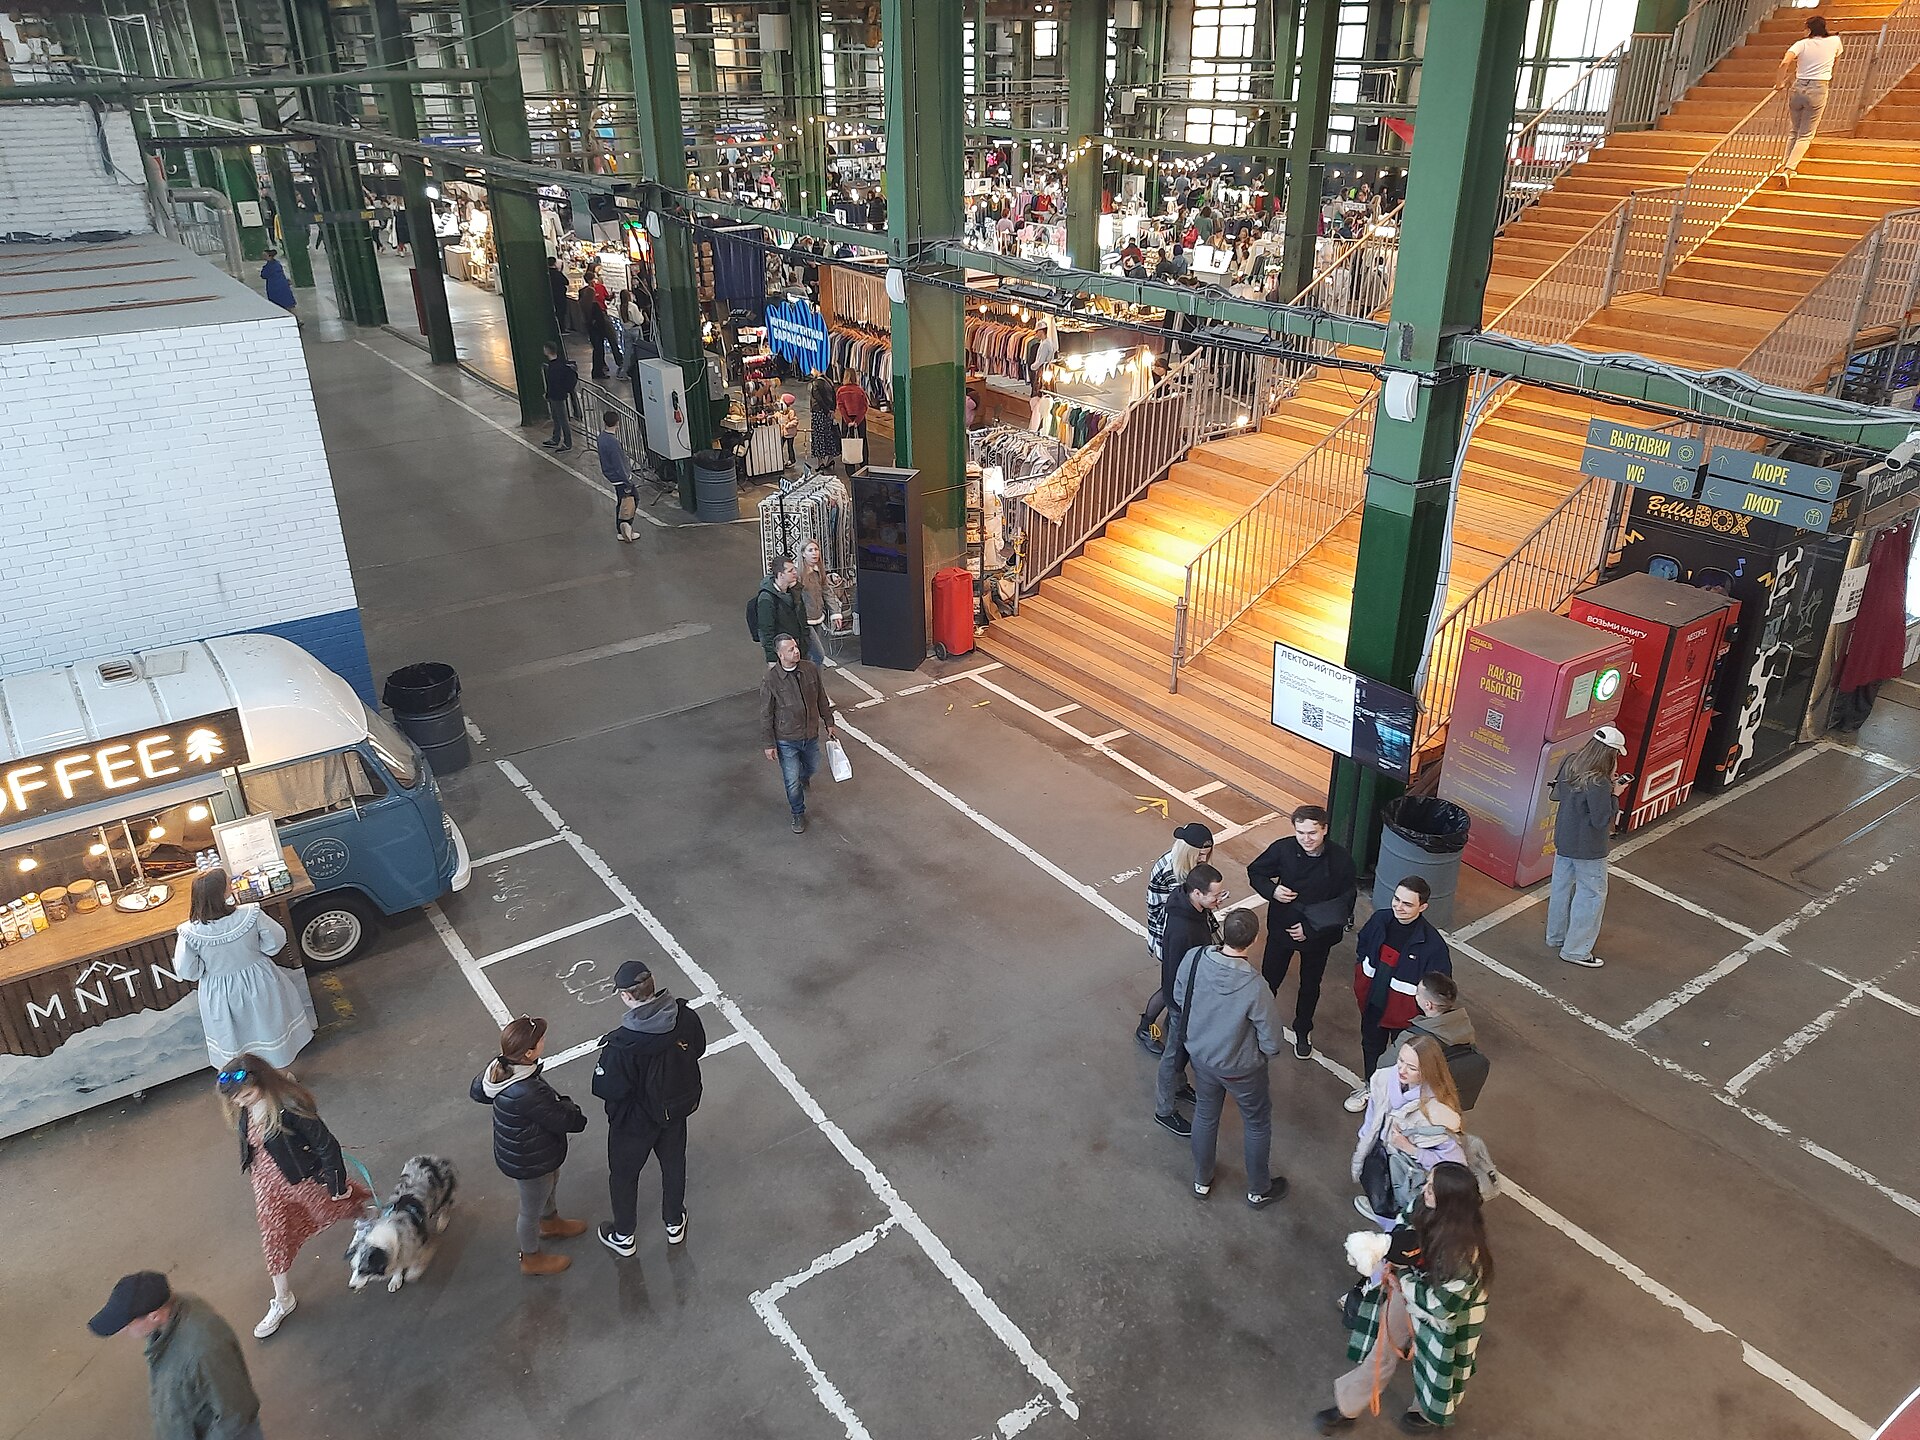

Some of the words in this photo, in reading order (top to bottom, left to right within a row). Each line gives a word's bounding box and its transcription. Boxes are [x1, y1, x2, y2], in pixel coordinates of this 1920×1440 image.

[773, 328, 818, 352] БАРАХОЛКА
[1609, 429, 1672, 458] ВЫСТАВКИ
[1625, 463, 1646, 484] WC
[1751, 461, 1791, 486] МОРЕ
[1646, 509, 1695, 525] KARAOKE
[1648, 495, 1694, 518] Bellis
[1693, 504, 1753, 538] BOX
[1742, 492, 1783, 517] ЛИФТ
[1586, 615, 1620, 631] ВОЗЬМИ
[1620, 626, 1648, 639] КНИГУ
[1487, 663, 1505, 682] КАК
[1505, 670, 1523, 689] ЭТО
[0, 735, 181, 815] FFEE
[305, 850, 345, 867] MNTN
